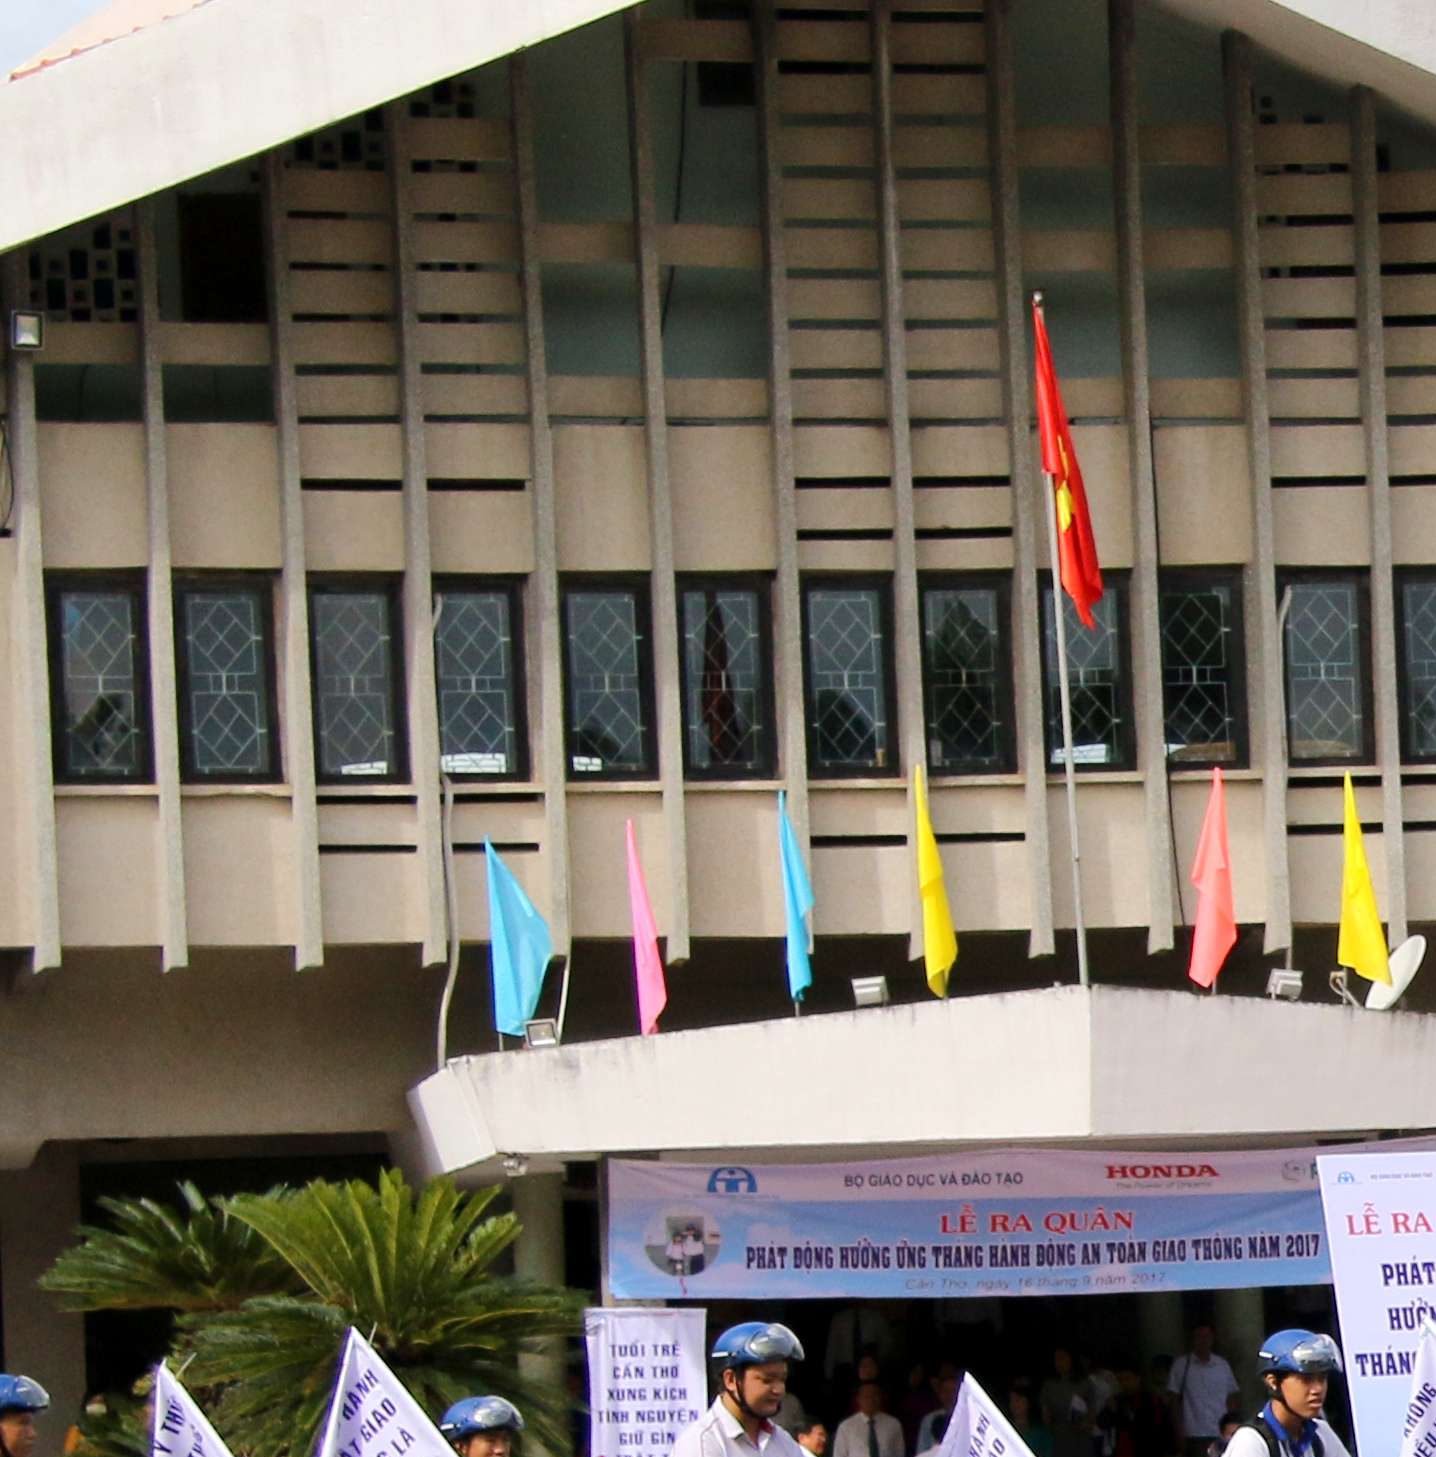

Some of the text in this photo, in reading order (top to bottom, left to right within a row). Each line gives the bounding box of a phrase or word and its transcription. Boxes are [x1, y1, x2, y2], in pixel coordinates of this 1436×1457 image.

[996, 1172, 1024, 1189] TẠO
[1105, 1164, 1219, 1179] HONDA
[940, 1202, 1133, 1235] LỄ RA QUÂN
[1346, 1202, 1381, 1236] LỄ
[1391, 1212, 1433, 1234] RA
[1081, 1243, 1101, 1264] AN
[1152, 1239, 1187, 1262] GIAO
[1286, 1233, 1320, 1258] 2017
[1381, 1255, 1435, 1287] PHÁT
[1355, 1345, 1417, 1377] THÁN
[607, 1387, 648, 1401] XUNG
[360, 1397, 396, 1443] GIAO
[391, 1426, 416, 1456] LÀ
